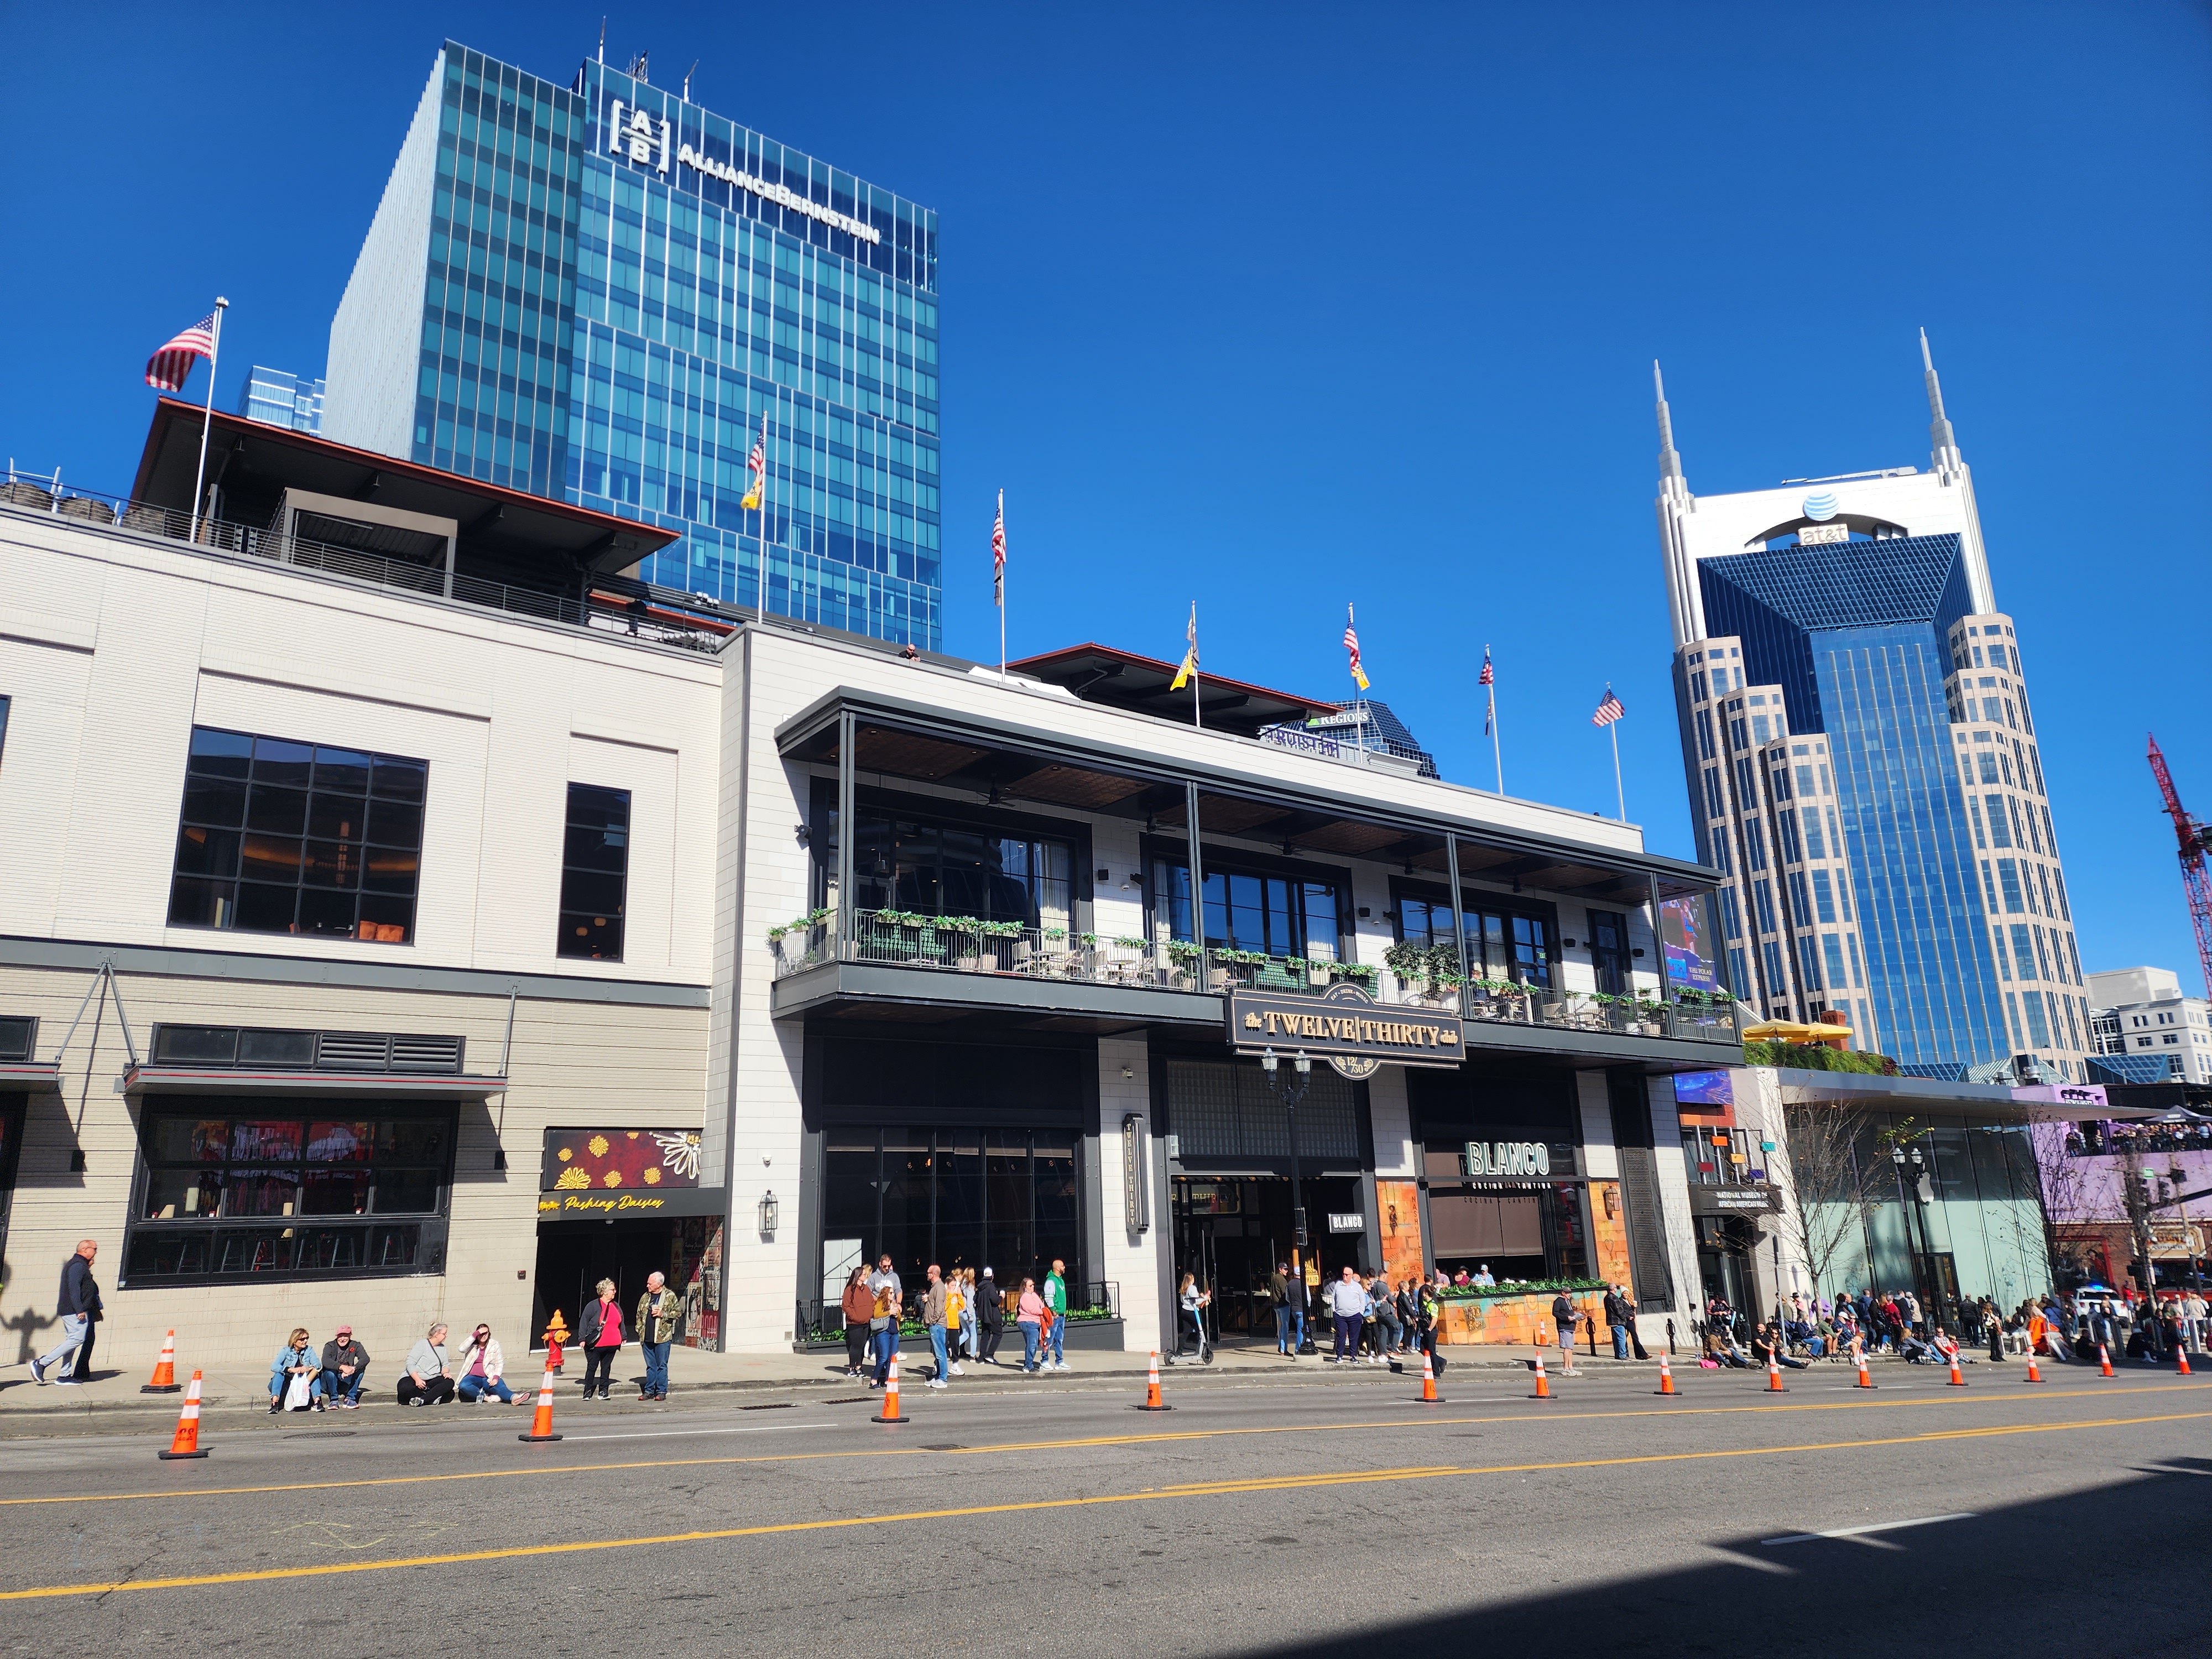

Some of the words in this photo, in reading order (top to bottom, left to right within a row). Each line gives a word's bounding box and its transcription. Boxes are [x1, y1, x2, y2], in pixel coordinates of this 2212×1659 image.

[1803, 525, 1847, 545] at&t
[1244, 1012, 1262, 1029] the
[1440, 1030, 1458, 1045] club
[1467, 1142, 1550, 1176] BLANCO
[565, 1196, 617, 1212] Pushing
[618, 1195, 665, 1211] Daisies
[1333, 1215, 1363, 1228] BLANCO
[1411, 1196, 1423, 1264] NASHVILLE
